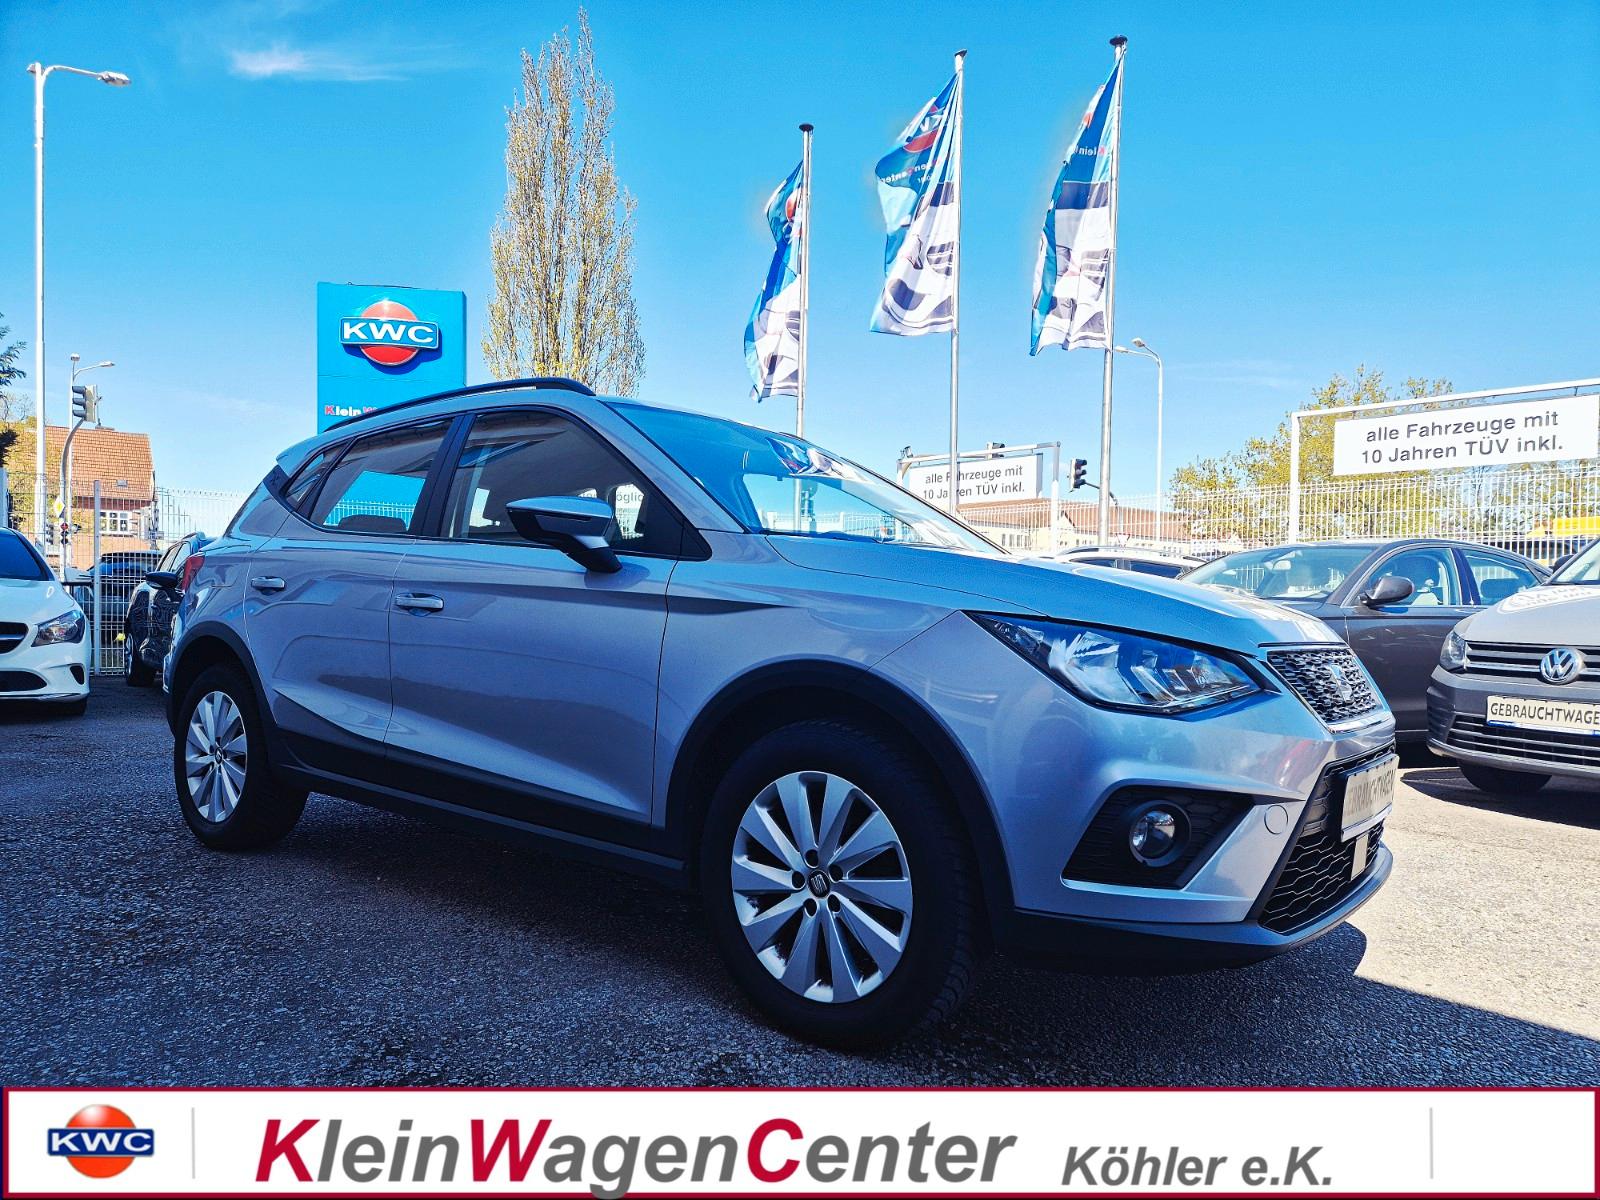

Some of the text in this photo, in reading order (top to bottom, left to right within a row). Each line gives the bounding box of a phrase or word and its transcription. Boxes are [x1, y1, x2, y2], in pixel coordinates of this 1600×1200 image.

[343, 322, 434, 343] KWC
[1366, 411, 1559, 442] alle Fahrzeuge mit
[1362, 435, 1563, 464] 10 Jahren TÜV inkl.
[925, 465, 1023, 484] alle Fhrzeuge mit
[923, 489, 934, 499] 10
[976, 482, 998, 496] TÜV
[1001, 482, 1025, 494] inkl.
